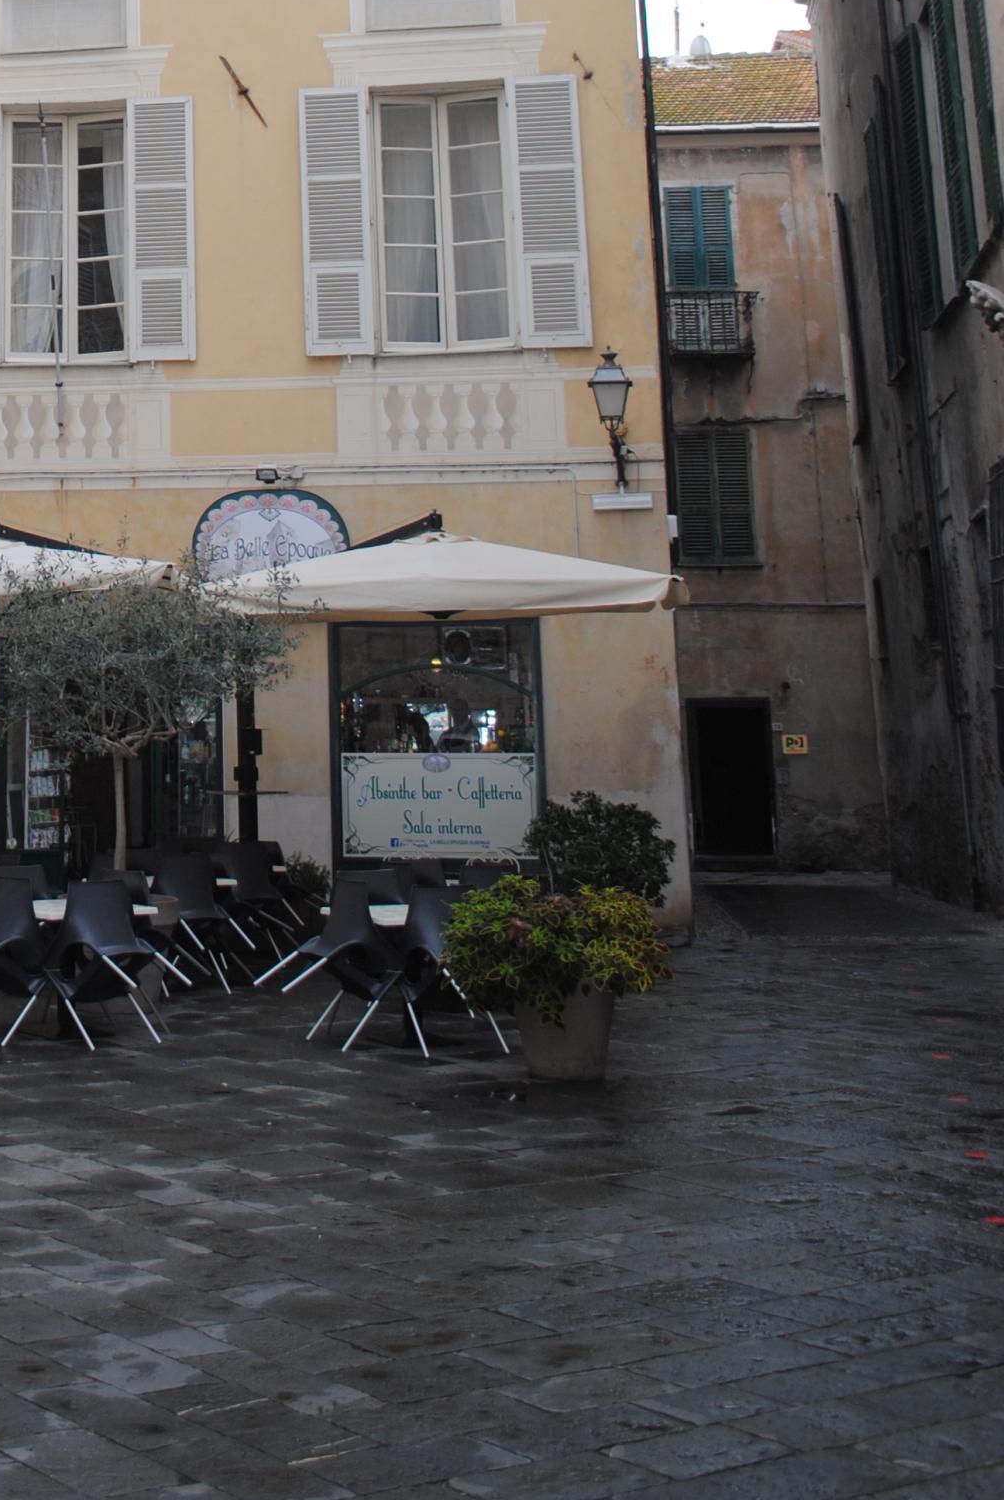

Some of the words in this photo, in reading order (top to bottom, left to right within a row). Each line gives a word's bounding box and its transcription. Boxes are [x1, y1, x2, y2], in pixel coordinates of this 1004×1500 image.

[210, 543, 229, 561] La
[236, 536, 269, 561] Belle
[357, 776, 417, 807] Absinthe
[421, 777, 443, 800] bar
[457, 776, 523, 809] Caffetteria
[403, 809, 433, 835] Sala
[437, 818, 483, 835] interna
